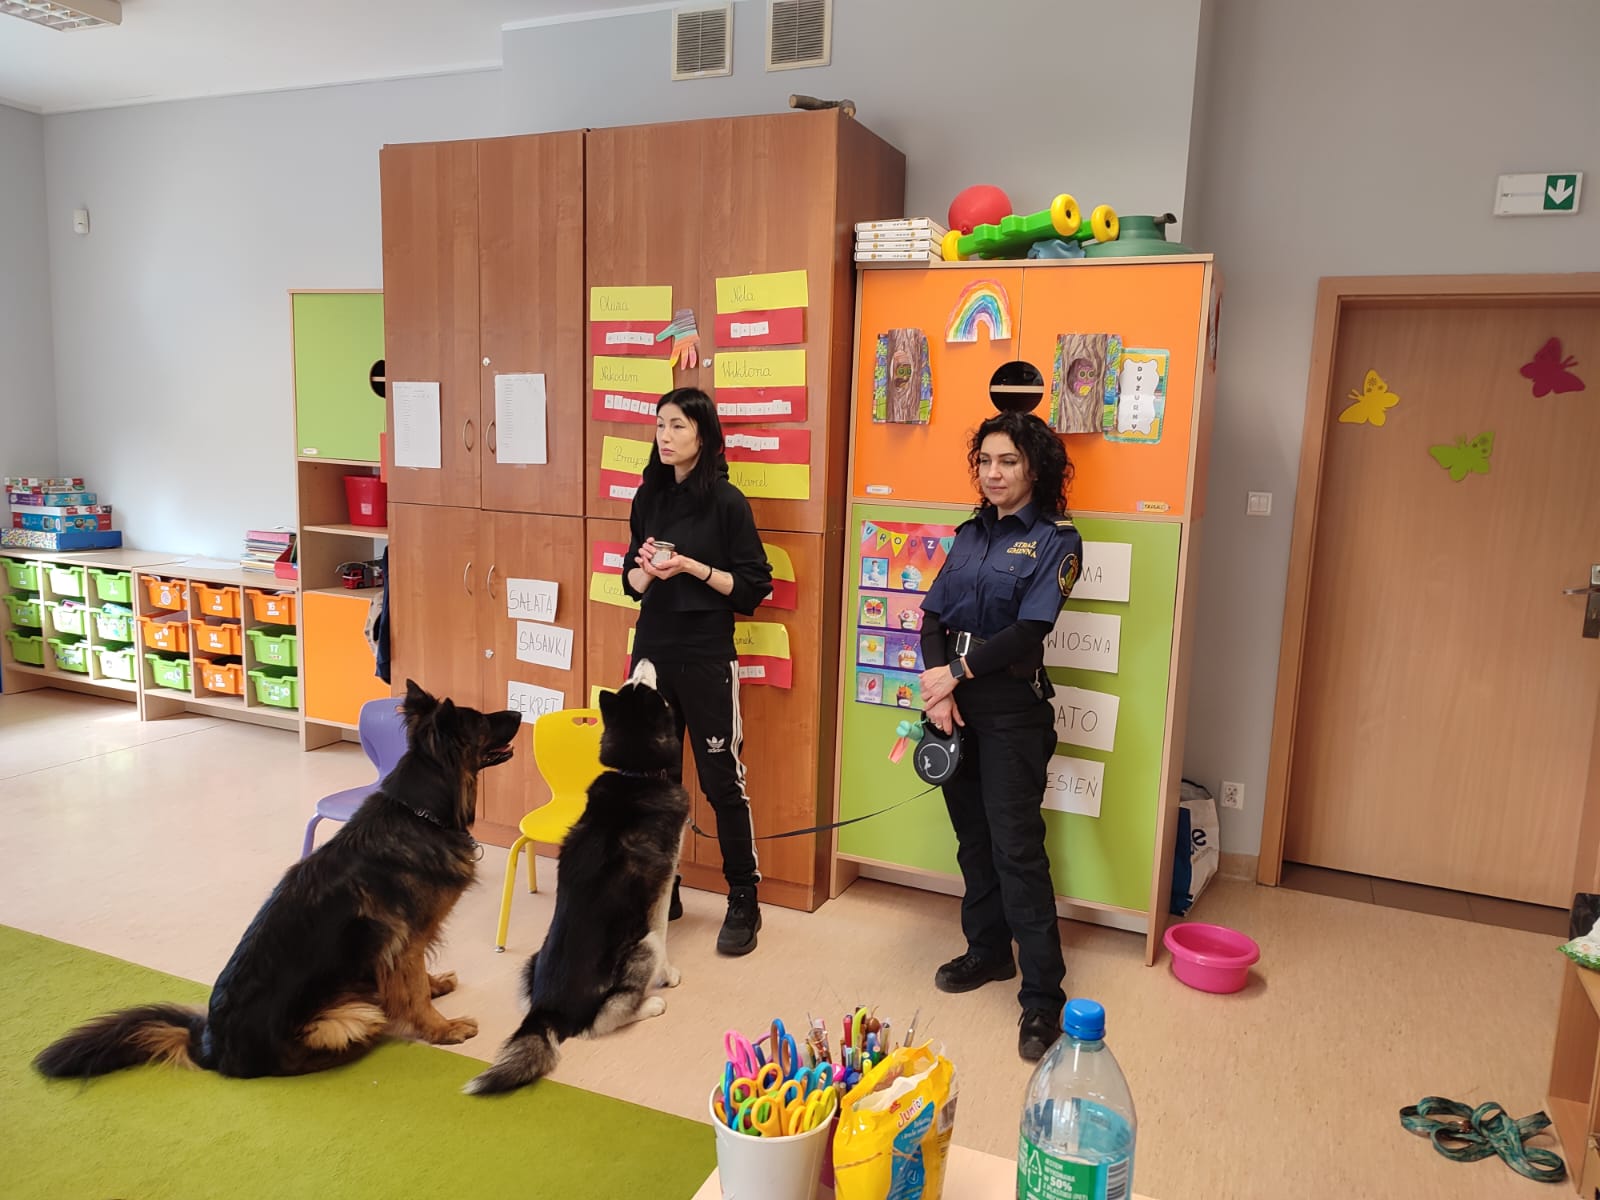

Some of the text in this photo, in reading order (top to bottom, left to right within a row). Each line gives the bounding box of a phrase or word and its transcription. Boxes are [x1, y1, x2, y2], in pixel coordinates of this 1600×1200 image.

[866, 526, 951, 549] URODZI
[1082, 566, 1102, 584] MA
[508, 589, 553, 614] SAŁATA
[518, 630, 567, 658] SASANKI
[1046, 631, 1111, 654] WIOSNA
[509, 693, 560, 716] SEKRET
[1056, 705, 1098, 733] ATO
[1047, 772, 1098, 798] ESIEŃ
[897, 1095, 924, 1128] Junior
[1050, 1175, 1073, 1192] 50%
